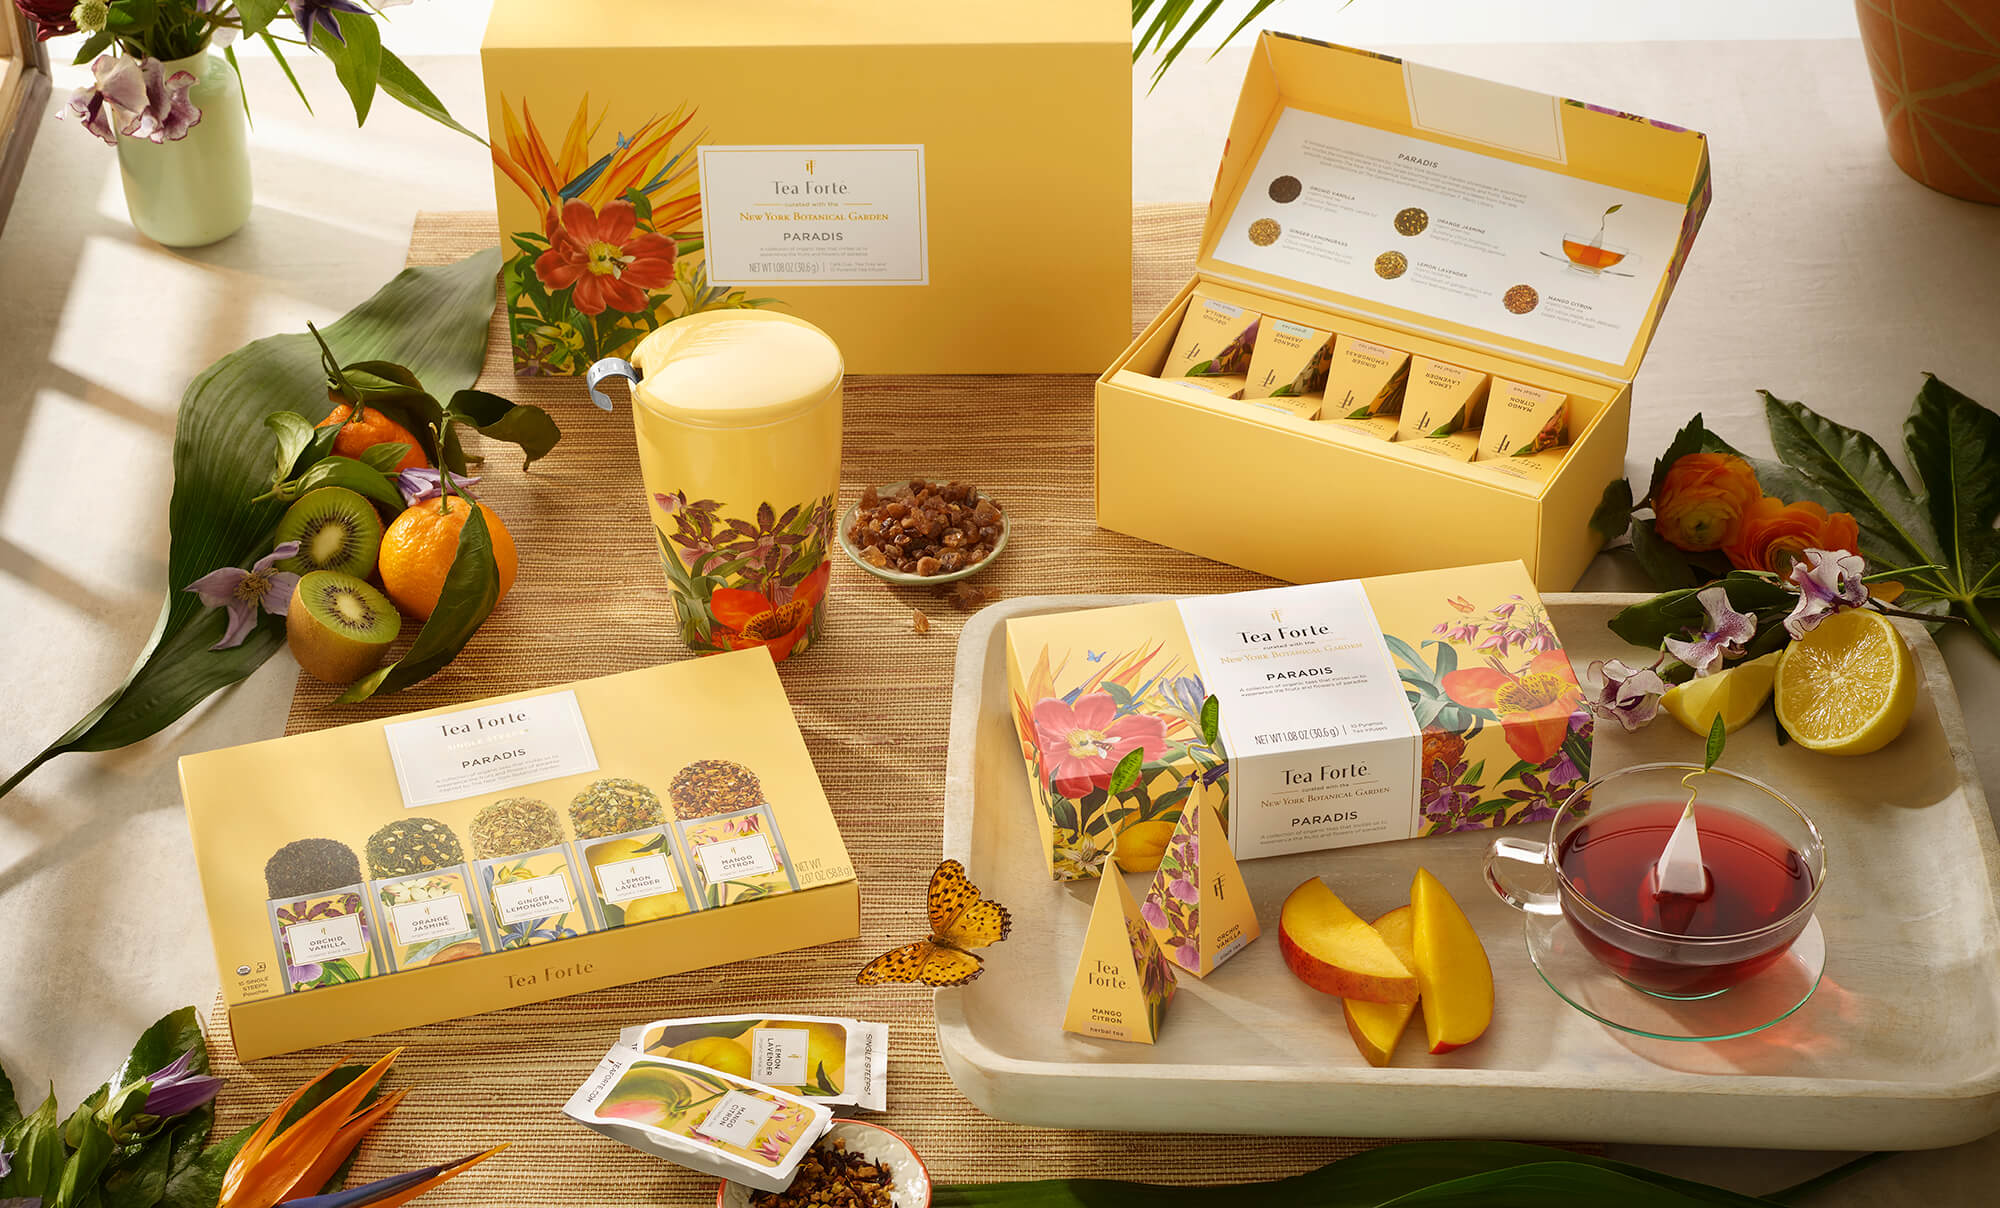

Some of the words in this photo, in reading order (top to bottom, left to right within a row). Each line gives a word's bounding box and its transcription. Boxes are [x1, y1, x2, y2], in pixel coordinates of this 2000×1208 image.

[1398, 153, 1439, 169] PARADIS
[771, 180, 799, 195] Tea
[1331, 190, 1356, 201] VANILLA
[1437, 217, 1461, 228] ORANGE
[1462, 224, 1486, 235] JASMINE
[783, 232, 844, 241] PARADIS
[1289, 227, 1310, 238] GINGER
[1312, 233, 1348, 247] LEMONGRASS
[749, 263, 760, 273] NET
[762, 262, 773, 273] WT
[785, 262, 794, 273] OZ
[1416, 261, 1436, 271] LEMON
[1436, 266, 1468, 278] LAVENDER
[1548, 295, 1569, 305] MANGO
[1570, 300, 1593, 311] CITRON
[1274, 338, 1300, 349] ORANGE
[1276, 332, 1304, 343] JASMINE
[1346, 350, 1389, 366] LEMONGRASS
[1352, 358, 1377, 369] GINGER
[1425, 372, 1461, 386] LAVENDER
[1429, 379, 1452, 390] LEMON
[1507, 402, 1533, 413] MANGO
[1509, 396, 1535, 408] CITRON
[1237, 630, 1272, 644] Tea
[1266, 666, 1333, 681] PARADIS
[436, 723, 471, 737] Tea
[1254, 734, 1269, 745] NET
[1269, 732, 1283, 744] WT
[1283, 731, 1299, 743] 1.08
[1299, 729, 1310, 740] OZ
[1309, 727, 1330, 740] (30.6
[1330, 725, 1340, 738] g)
[462, 748, 526, 769] PARADIS
[1280, 769, 1313, 785] Tea
[1291, 811, 1358, 827] PARADIS
[721, 854, 753, 865] MANGO
[723, 859, 755, 870] CITRON
[795, 860, 810, 873] NET
[810, 858, 823, 870] WT
[615, 878, 661, 892] LAVENDER
[621, 875, 652, 885] LEMON
[506, 897, 565, 914] LEMONGRASS
[517, 894, 550, 906] GINGER
[411, 915, 449, 927] ORANGE
[413, 919, 451, 932] JASMINE
[1216, 924, 1240, 942] ORCHID
[1216, 929, 1242, 950] VANILLA
[308, 940, 347, 952] VANILLA
[309, 935, 343, 947] ORCHID
[1092, 960, 1119, 976] Tea
[503, 975, 537, 990] Tea
[1091, 1008, 1122, 1018] MANGO
[1091, 1015, 1123, 1025] CITRON
[1089, 1026, 1111, 1035] herbal
[1112, 1029, 1124, 1037] tea
[865, 1033, 873, 1062] SINGLE
[766, 1037, 774, 1077] LAVENDER
[774, 1044, 782, 1070] LEMON
[586, 1061, 622, 1103] TEAFORTE.COM
[720, 1104, 739, 1126] CITRON
[726, 1106, 746, 1128] MANGO
